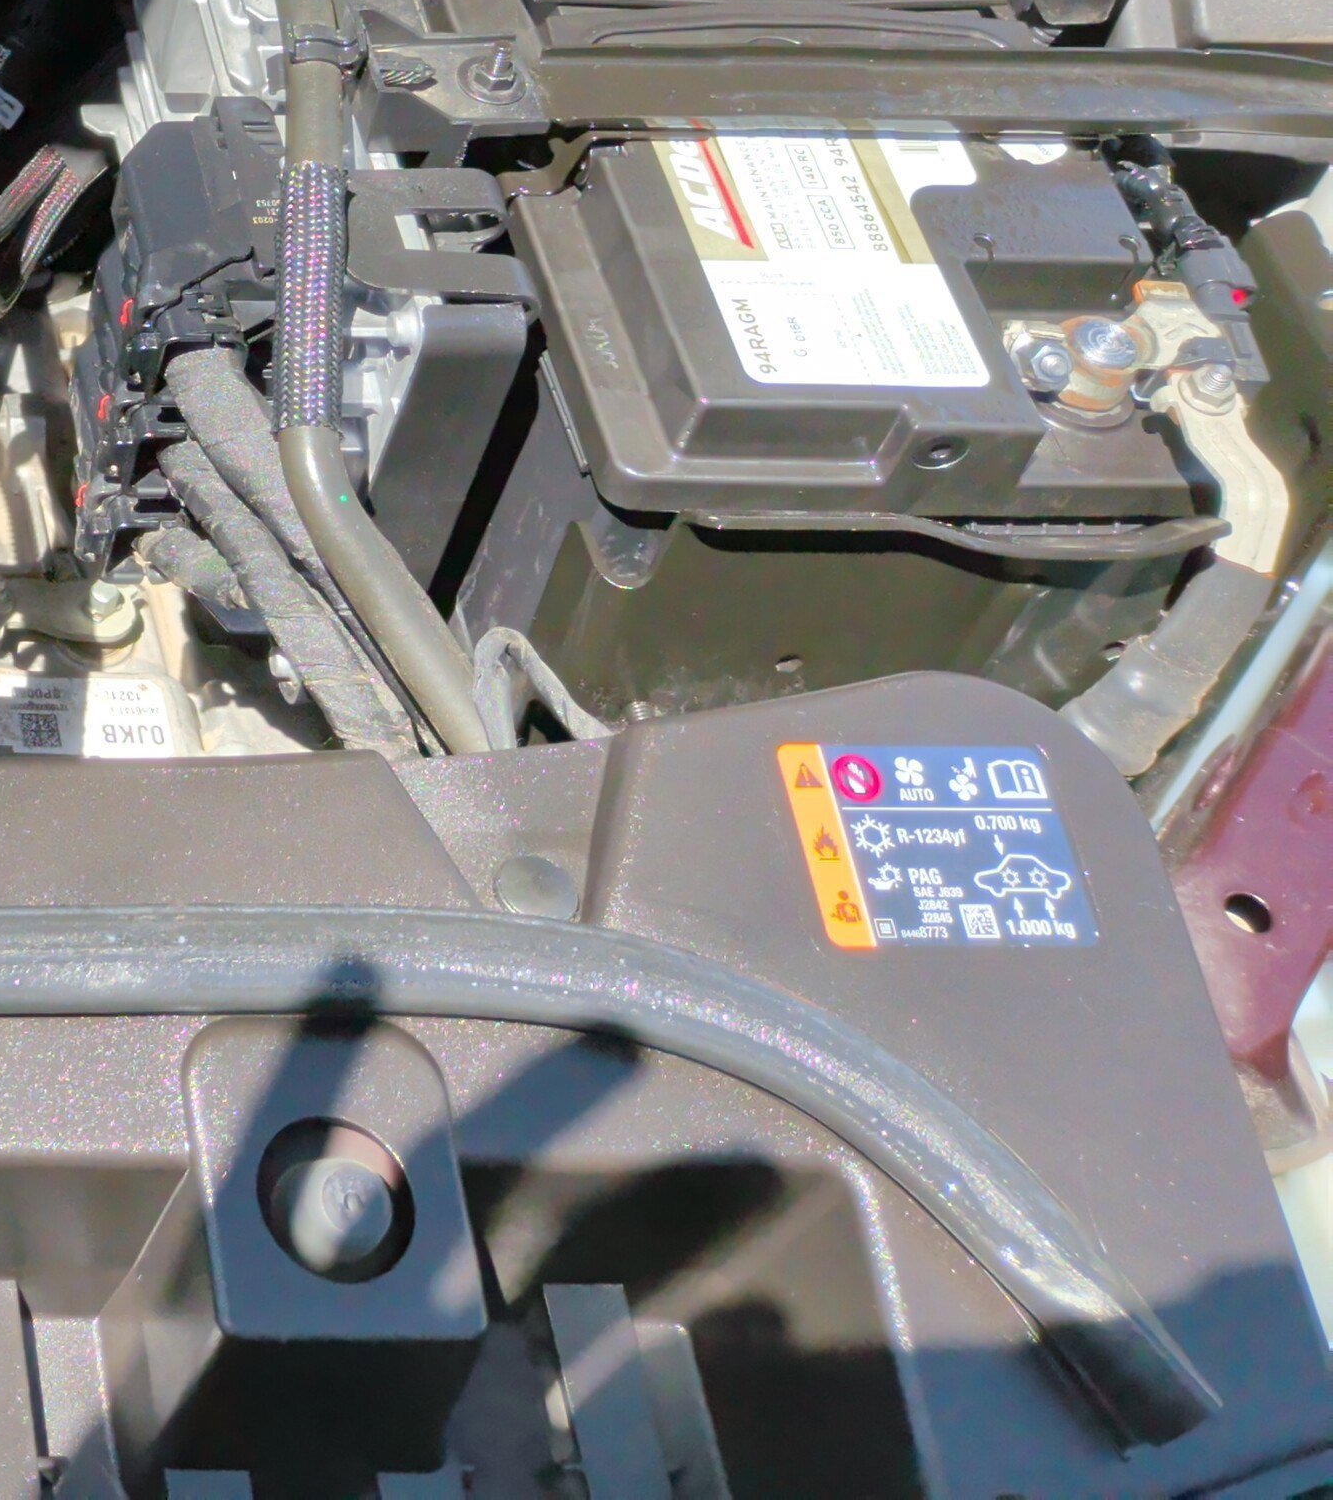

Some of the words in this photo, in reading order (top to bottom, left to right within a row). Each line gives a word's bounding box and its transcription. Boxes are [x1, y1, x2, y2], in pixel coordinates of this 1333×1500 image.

[792, 147, 809, 161] RC
[735, 139, 778, 219] MAINTENANCE
[800, 164, 819, 184] 140
[815, 199, 835, 220] CCA
[840, 175, 889, 251] 88864542
[825, 223, 846, 244] 850
[730, 299, 779, 373] 94RAGM
[900, 788, 934, 802] AUTO
[975, 815, 1016, 831] 0.700
[1020, 816, 1041, 834] kg
[896, 828, 967, 846] R-1234yf
[909, 868, 942, 885] PAG
[914, 887, 935, 898] SAE
[938, 887, 963, 898] J639
[918, 899, 949, 911] J2842
[1006, 919, 1049, 937] 1.000
[1054, 921, 1076, 939] kg
